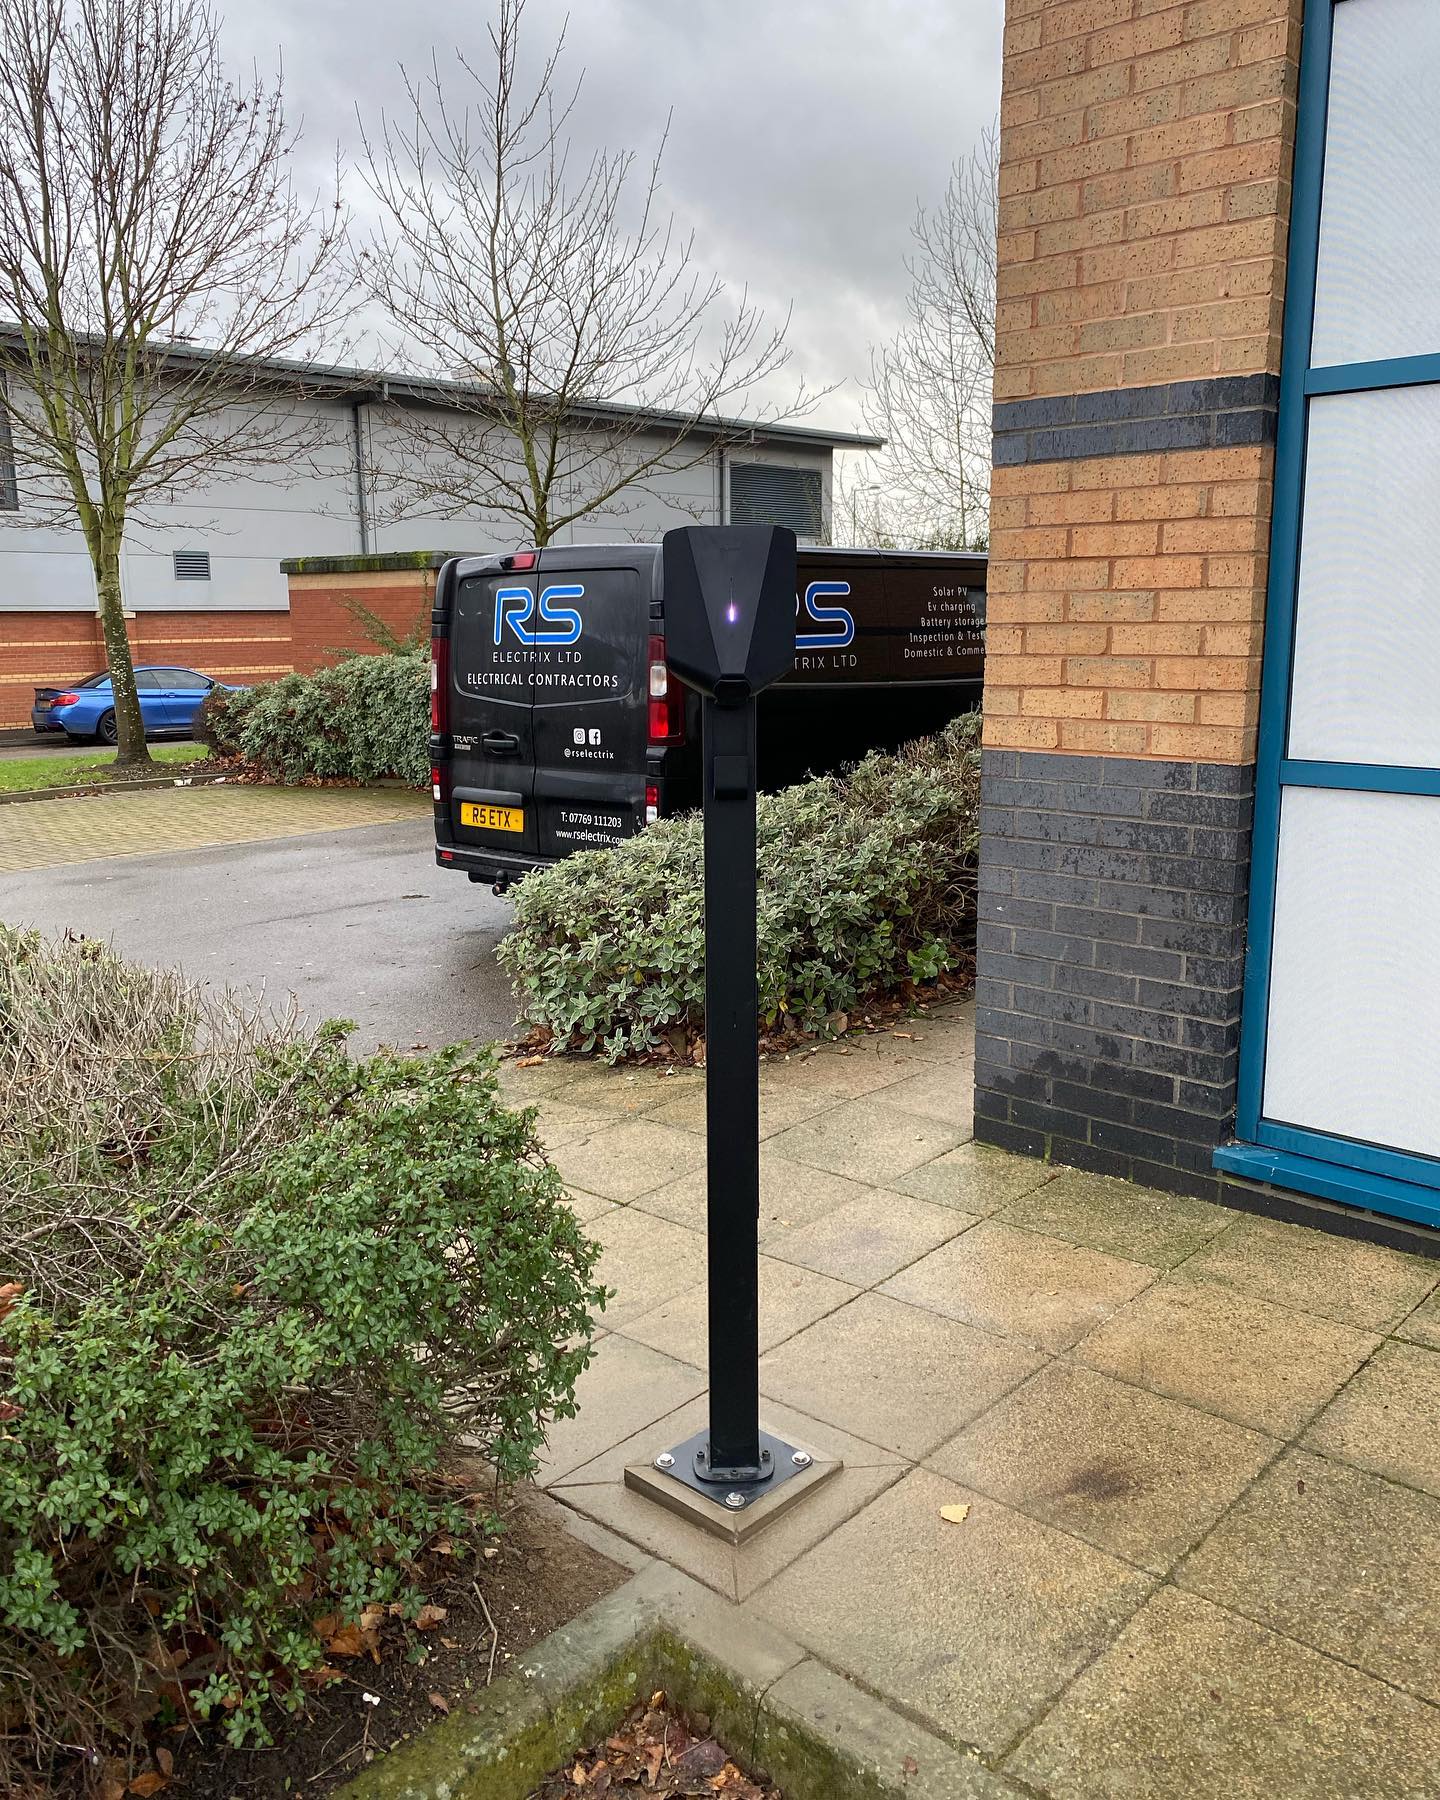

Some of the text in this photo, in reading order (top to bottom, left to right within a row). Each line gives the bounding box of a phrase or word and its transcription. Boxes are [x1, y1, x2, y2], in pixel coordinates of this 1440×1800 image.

[932, 586, 968, 597] Solar PV
[927, 602, 976, 614] Ev charging
[494, 585, 585, 646] RS
[796, 581, 855, 650] S
[920, 617, 985, 629] Battery storage
[909, 632, 955, 644] Inspection
[957, 631, 964, 641] &
[492, 651, 582, 663] ELECTRIX LTD
[904, 648, 943, 659] Domestic
[946, 646, 953, 656] &
[833, 654, 857, 668] LTD
[467, 672, 618, 688] ELECTRICAL CONTRACTORS
[452, 734, 479, 744] TRAFIC
[563, 747, 615, 759] @rselectrix
[489, 808, 511, 827] ETX
[560, 811, 622, 828] T: 07769 111203
